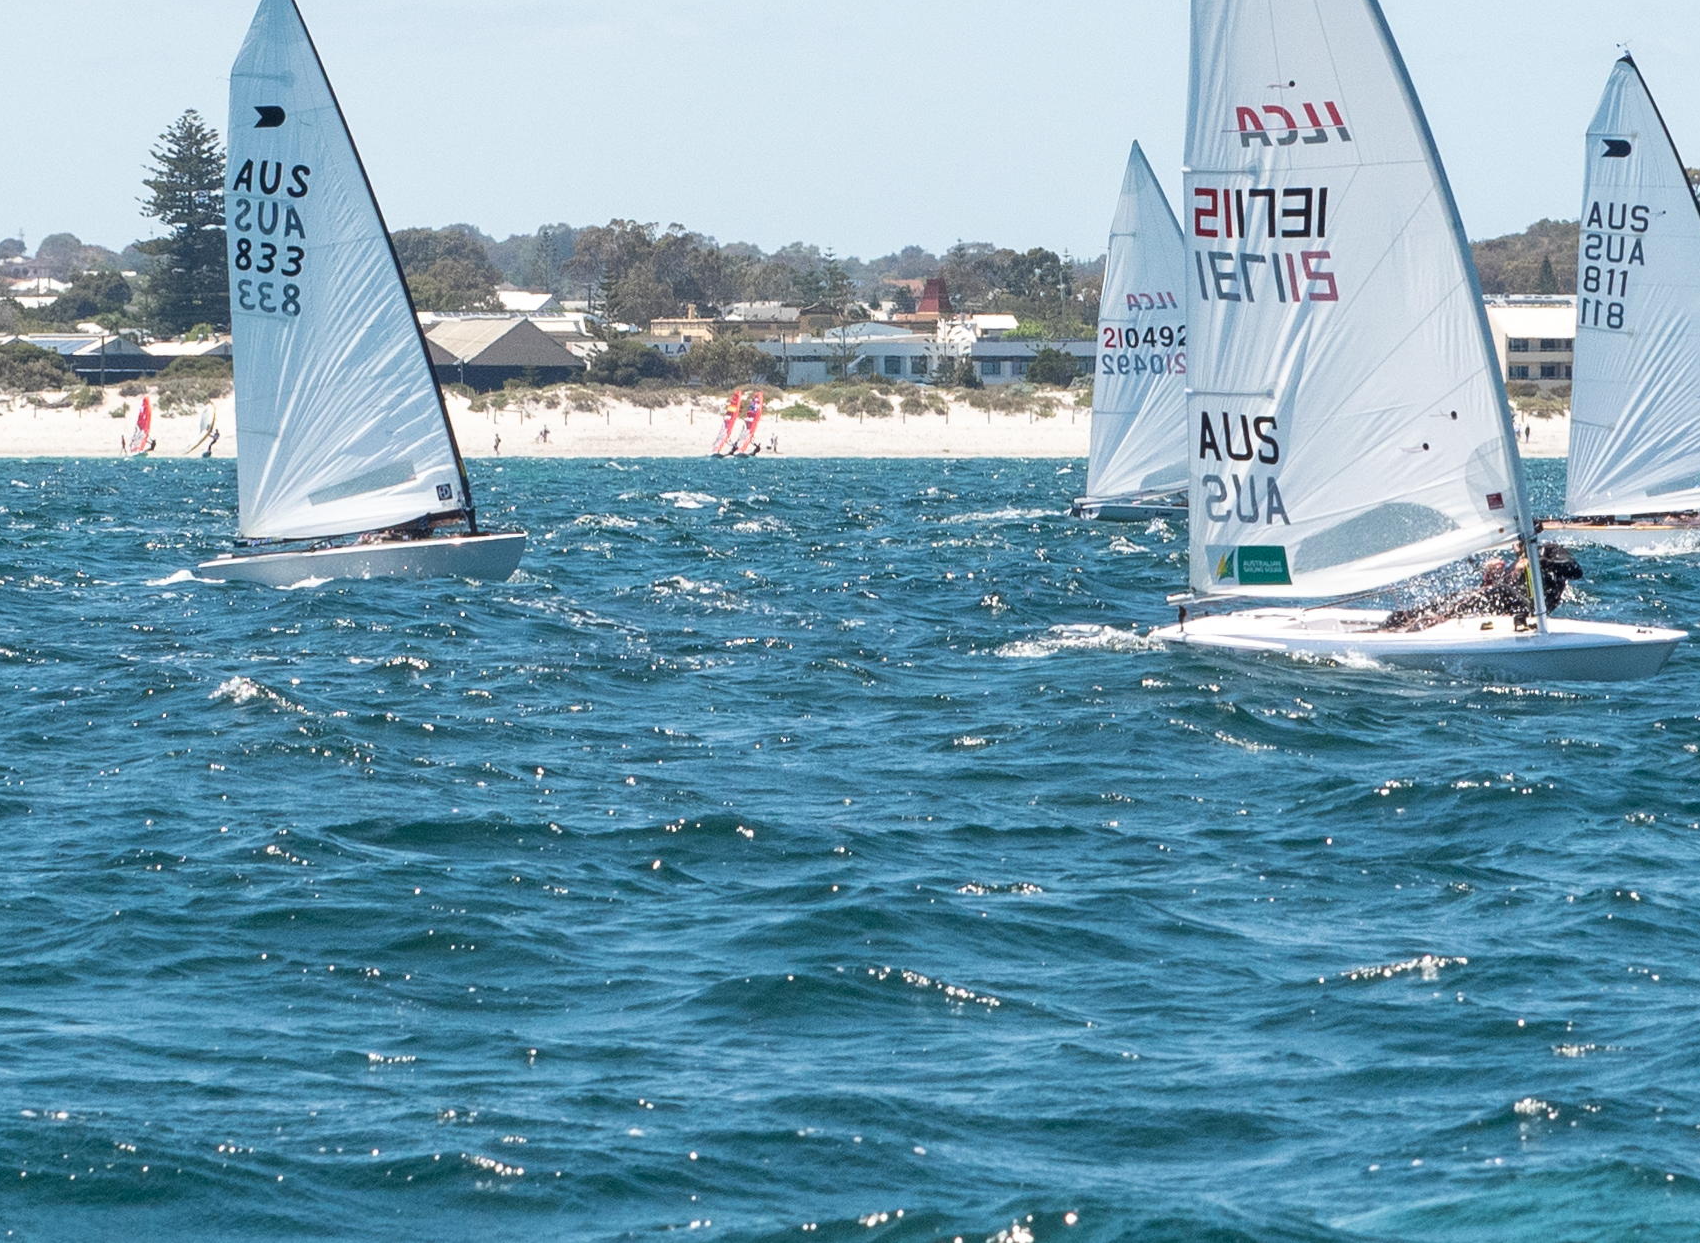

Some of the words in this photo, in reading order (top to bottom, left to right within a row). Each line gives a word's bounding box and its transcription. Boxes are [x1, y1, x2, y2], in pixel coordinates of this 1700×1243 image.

[232, 158, 311, 198] AUS
[1194, 187, 1328, 239] 211731
[1586, 201, 1650, 233] AUS
[235, 238, 305, 277] 833
[1583, 265, 1629, 297] 811
[1103, 324, 1186, 349] 210492
[1199, 411, 1280, 465] AUS
